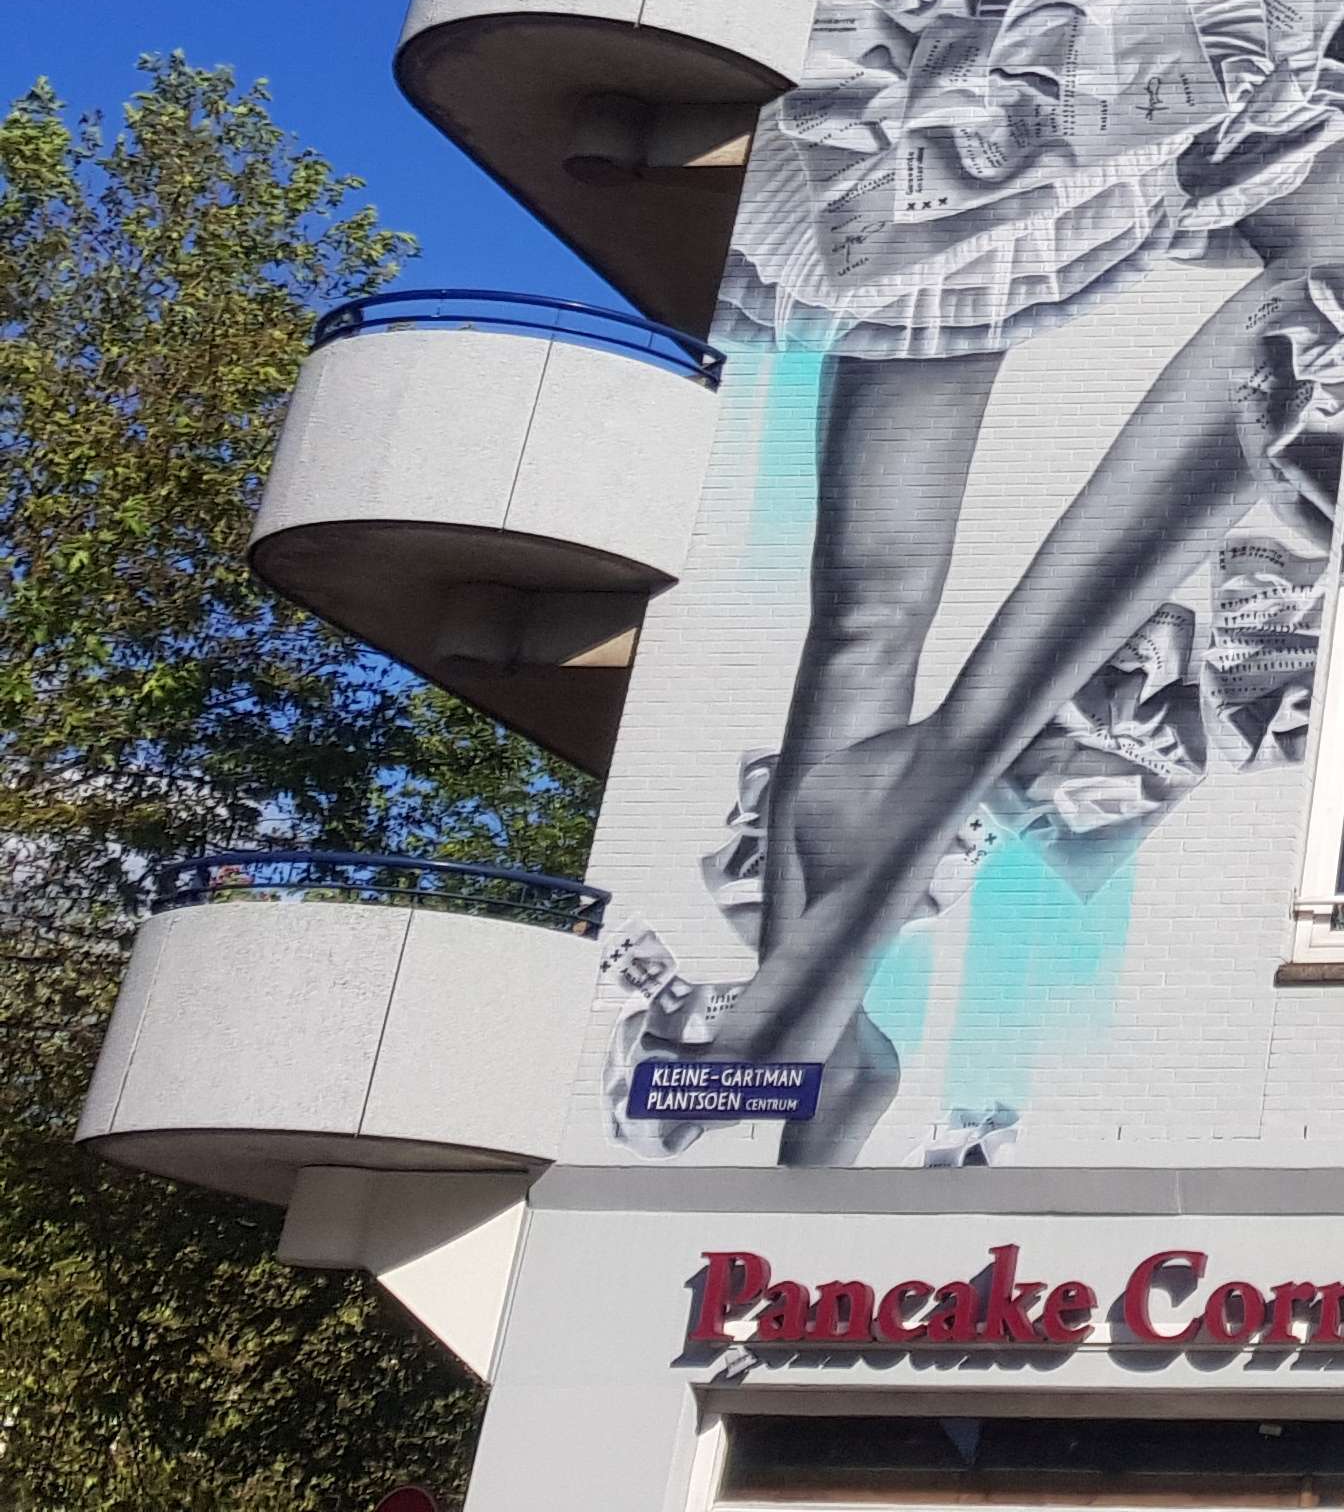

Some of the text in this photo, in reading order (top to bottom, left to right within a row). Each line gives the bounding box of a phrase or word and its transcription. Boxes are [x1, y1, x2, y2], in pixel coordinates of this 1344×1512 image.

[651, 1067, 803, 1087] KLEINE-GARTMAN
[647, 1091, 797, 1111] PLANTSOEN CENTRUM
[690, 1244, 1097, 1344] Pancake
